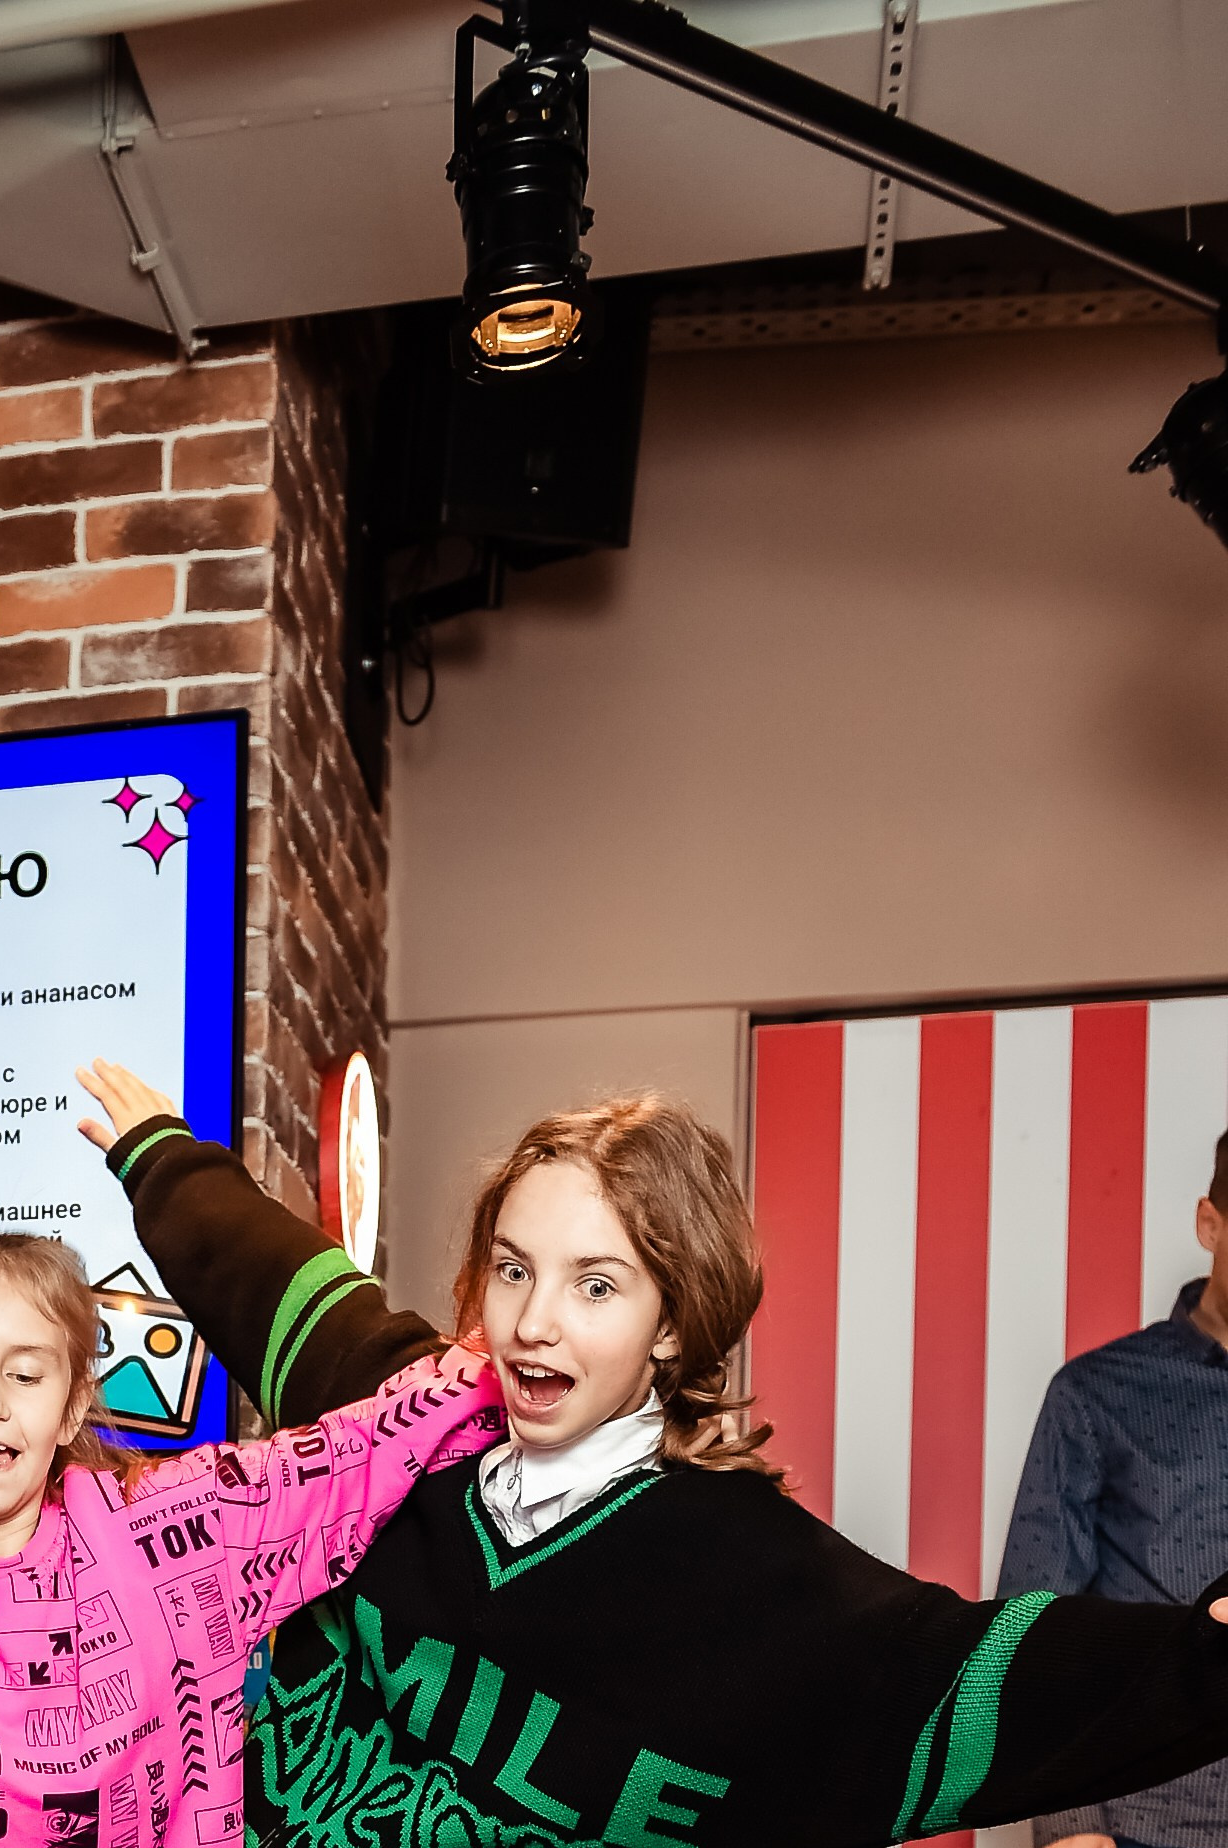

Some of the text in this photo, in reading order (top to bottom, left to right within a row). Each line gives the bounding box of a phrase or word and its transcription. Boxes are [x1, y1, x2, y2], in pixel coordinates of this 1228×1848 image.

[1, 991, 14, 1006] и
[21, 980, 136, 1005] ананасом
[3, 1067, 15, 1083] с
[55, 1094, 68, 1111] и
[128, 1508, 169, 1532] DON'T
[190, 1573, 237, 1660] MY WAY
[25, 1705, 79, 1748] MY
[14, 1715, 166, 1775] MUSIC OF MY SOUL
[108, 1772, 139, 1826] MY
